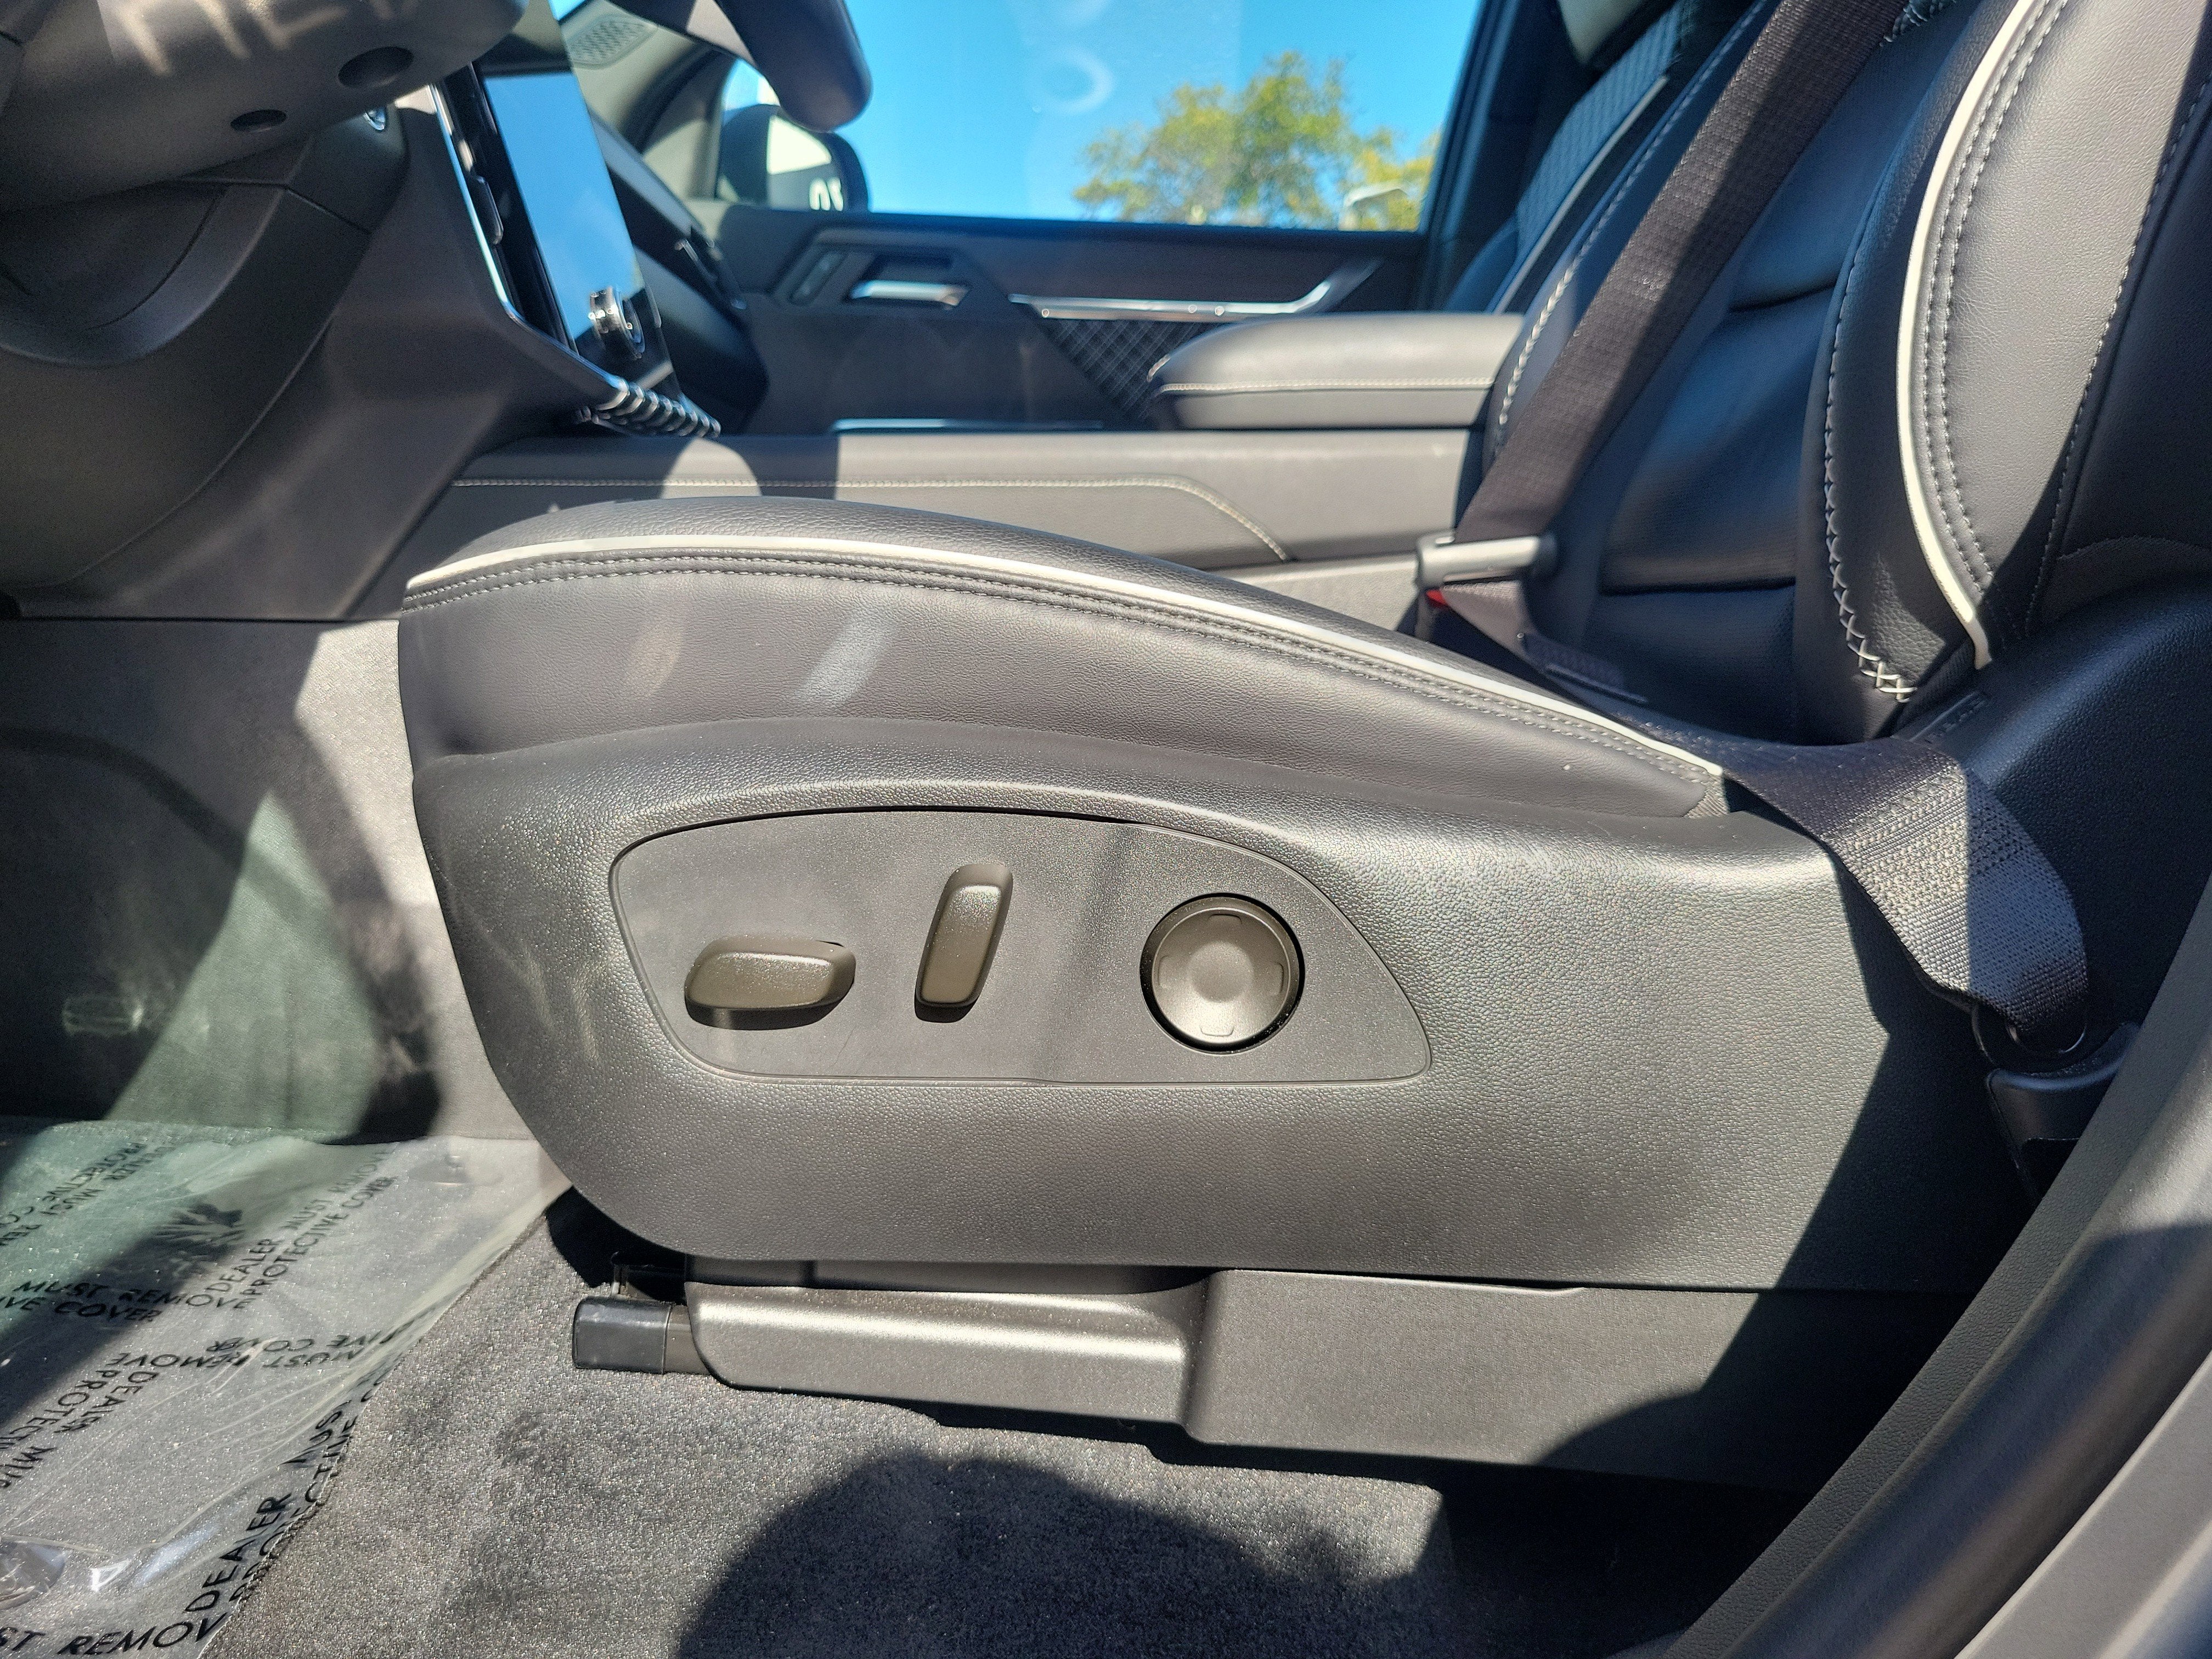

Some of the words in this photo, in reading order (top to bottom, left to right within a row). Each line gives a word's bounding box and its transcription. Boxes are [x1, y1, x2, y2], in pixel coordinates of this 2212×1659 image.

[205, 1238, 285, 1292] DEALER
[240, 1213, 349, 1295] PROTECTIVE
[12, 1280, 109, 1298] MUST
[118, 1288, 257, 1310] REMOVE
[55, 1301, 162, 1322] COVER
[53, 1372, 160, 1434] DEALER
[184, 1493, 292, 1612] DEALER
